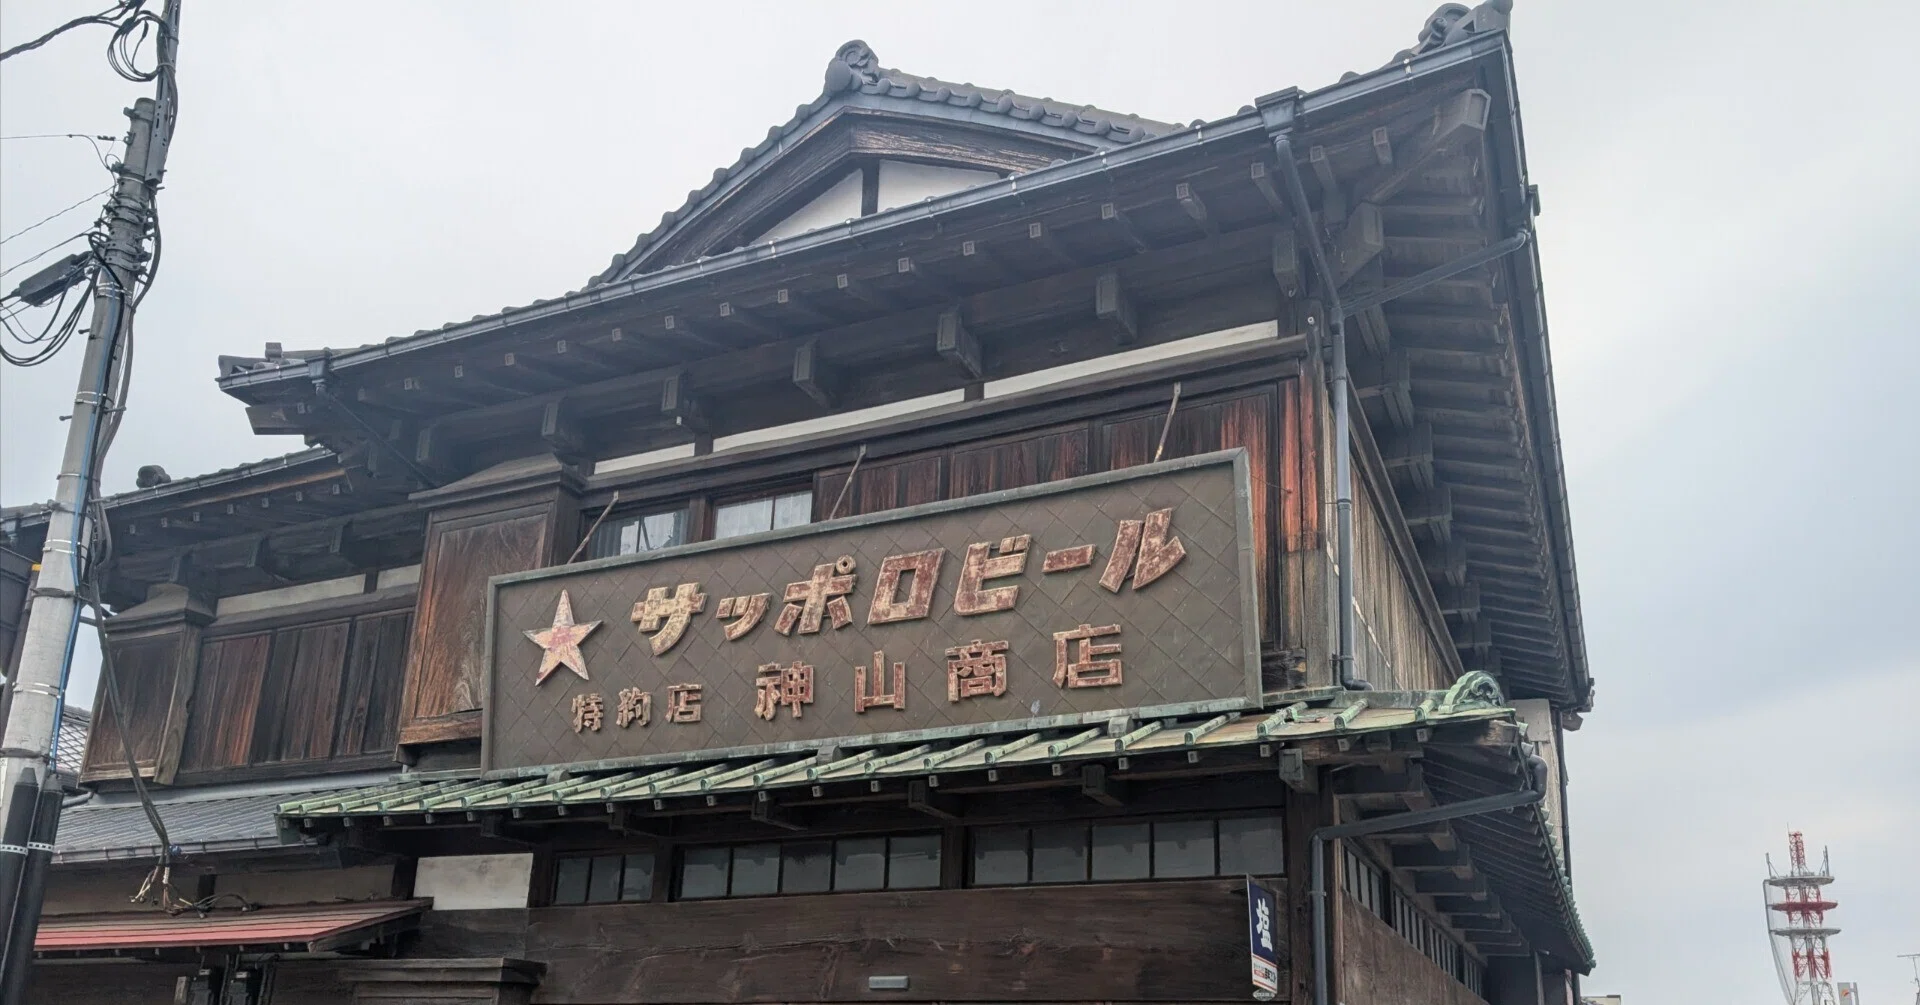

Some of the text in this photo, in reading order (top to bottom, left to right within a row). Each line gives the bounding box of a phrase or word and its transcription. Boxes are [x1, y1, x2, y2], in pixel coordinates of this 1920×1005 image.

[630, 507, 1186, 656] サッポロビール
[571, 623, 1123, 733] 特約店 神山商店
[1255, 897, 1273, 952] 塩
